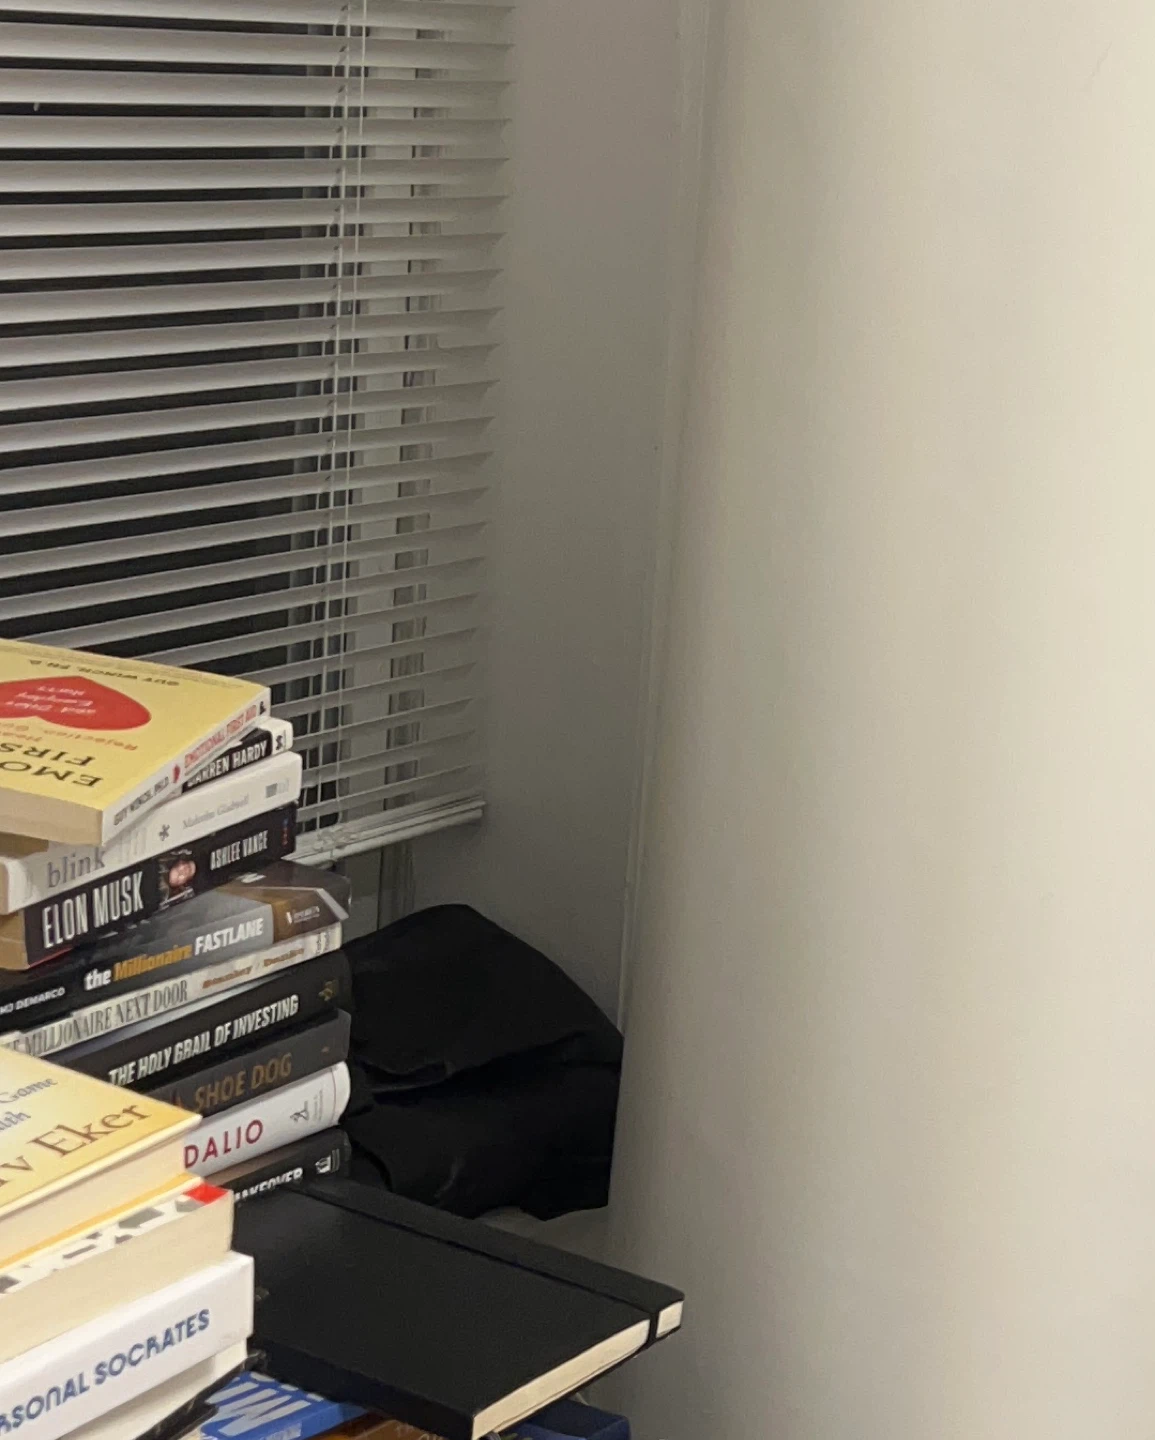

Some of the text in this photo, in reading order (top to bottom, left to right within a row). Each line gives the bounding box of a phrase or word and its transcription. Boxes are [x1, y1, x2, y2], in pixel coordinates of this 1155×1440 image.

[231, 739, 268, 768] HARDY
[46, 846, 106, 888] blink
[210, 829, 269, 872] ASHLEE VANCE
[41, 870, 144, 949] ELON MUSK
[84, 918, 264, 991] the Millionaire FASTLANE
[15, 987, 66, 1010] DEMARCO
[152, 980, 188, 1013] DOOR
[108, 994, 299, 1088] THE HOLY GRAIL OF INVESTING
[194, 1053, 292, 1112] SHOE DOG
[26, 1104, 152, 1158] Eker
[183, 1118, 264, 1170] DALIO
[95, 1309, 210, 1386] SOCRATES
